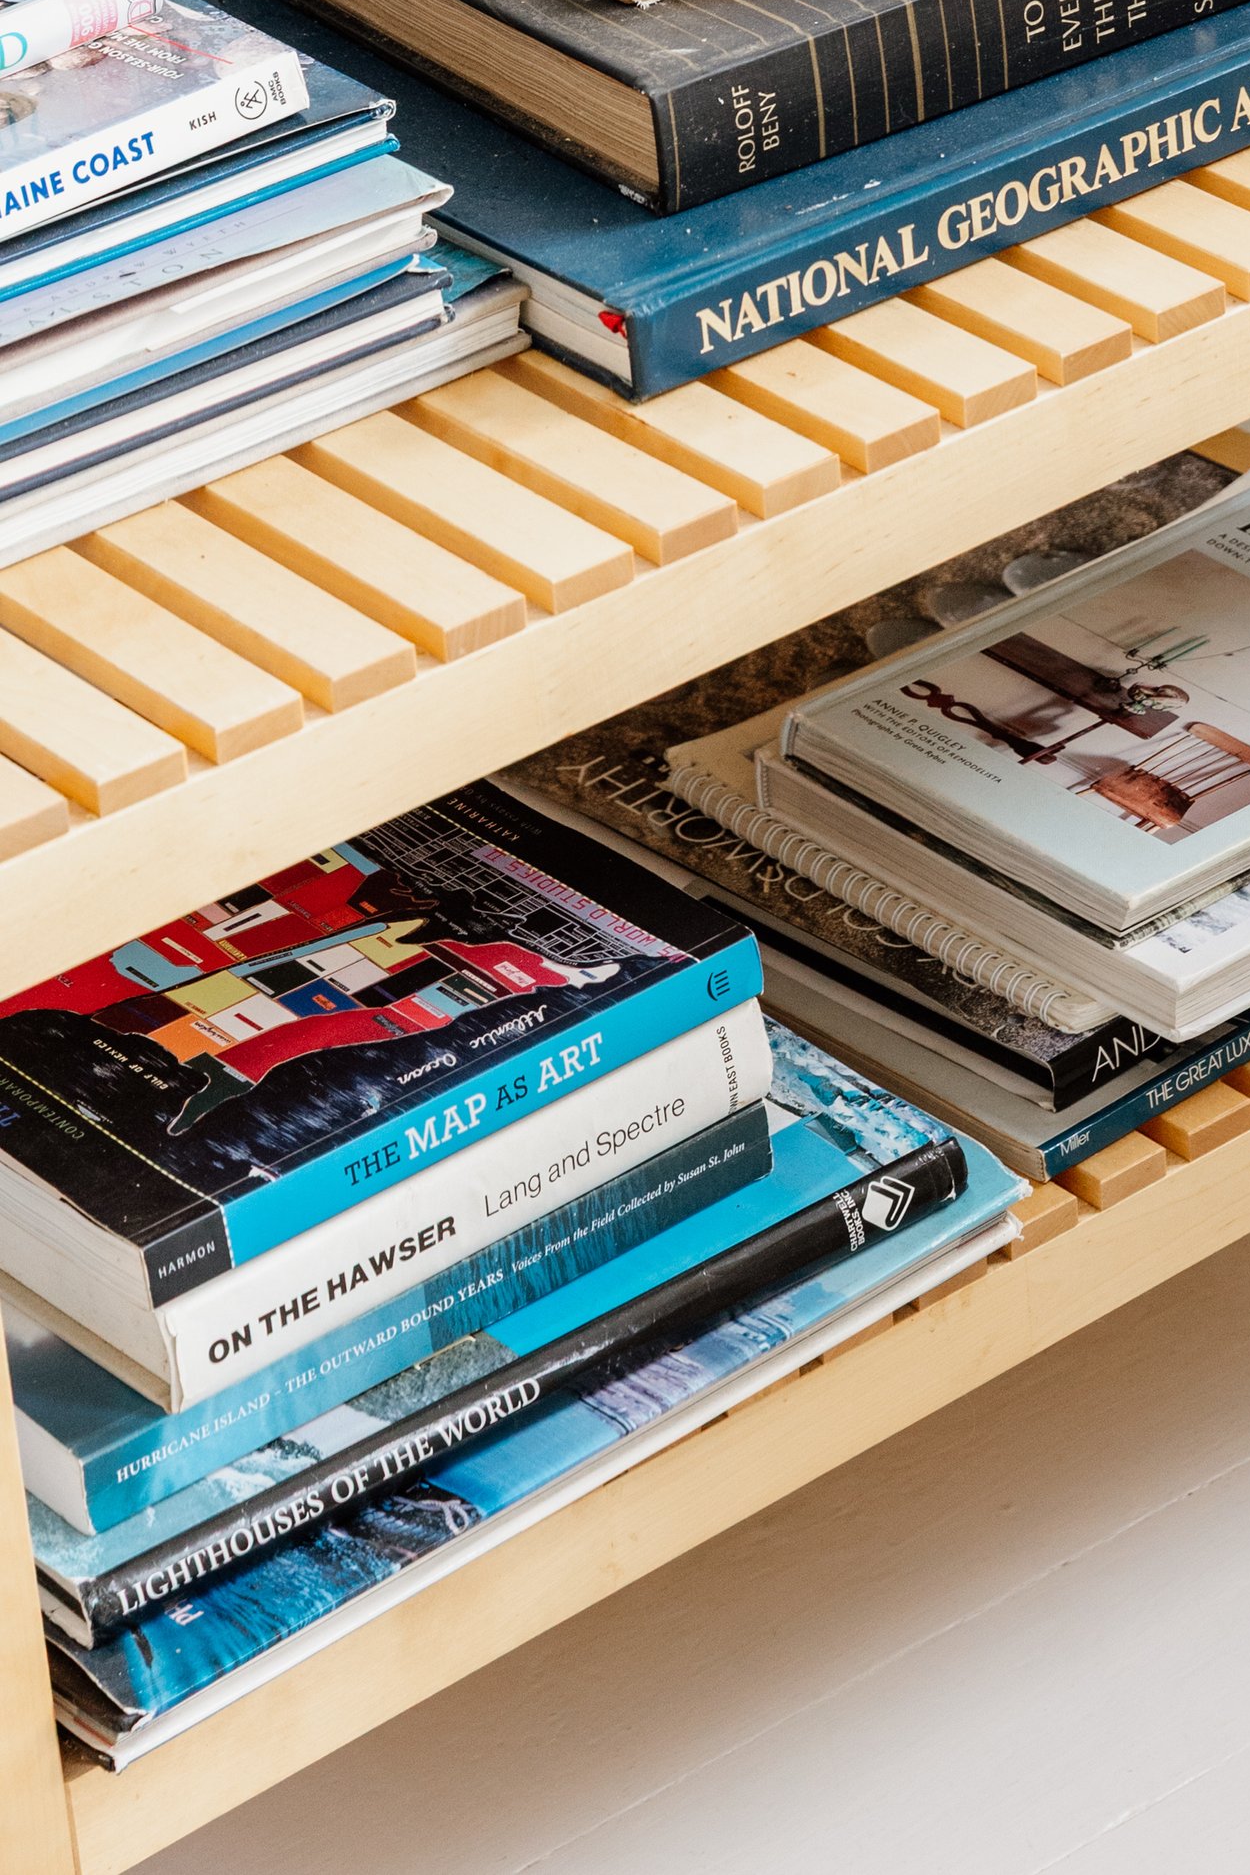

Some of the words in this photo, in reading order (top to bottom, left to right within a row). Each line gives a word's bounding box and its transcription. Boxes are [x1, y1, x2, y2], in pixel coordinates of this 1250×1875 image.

[124, 37, 149, 52] THE
[1024, 0, 1045, 43] TO
[99, 44, 184, 80] FOUR-SEASON
[149, 46, 187, 65] FROM
[268, 79, 279, 102] AMC
[273, 71, 286, 105] BOOKS
[731, 84, 755, 174] ROLOFF
[760, 91, 779, 151] BENY
[0, 170, 65, 219] AINE
[72, 131, 155, 185] COAST
[189, 111, 217, 131] KISH
[697, 223, 929, 354] NATIONAL
[936, 97, 1221, 253] GEOGRAPHIC
[1217, 532, 1228, 541] A
[851, 708, 894, 737] Photographs
[893, 733, 903, 743] by
[902, 738, 925, 754] Greta
[924, 750, 947, 765] Rybus
[863, 702, 886, 720] WITH
[885, 715, 901, 728] THE
[900, 725, 937, 747] EDITORS
[936, 745, 949, 754] OF
[947, 750, 1003, 784] REMODELISTA
[871, 698, 909, 719] ANNIE
[908, 717, 916, 727] P.
[917, 723, 967, 751] QUIGLEY
[447, 797, 520, 842] KATHARINE
[504, 860, 593, 911] STUDIES
[589, 909, 652, 948] WORLD
[92, 1038, 128, 1063] MEXICO
[469, 1004, 548, 1050] Atlantic
[716, 1025, 733, 1063] BOOKS
[397, 1053, 457, 1085] Ocean
[725, 1065, 738, 1092] EAST
[0, 1078, 85, 1140] CONTEMPORAR
[1059, 1128, 1091, 1157] Miller
[1146, 1085, 1174, 1109] THE
[1175, 1052, 1224, 1093] GREAT
[158, 1240, 217, 1279] HARMON
[344, 1142, 401, 1188] THE
[403, 1094, 487, 1161] MAP
[495, 1075, 529, 1111] AS
[536, 1031, 603, 1095] ART
[208, 1324, 253, 1364] ON
[258, 1287, 321, 1336] THE
[326, 1215, 457, 1304] HAWSER
[484, 1173, 544, 1217] Lang
[549, 1142, 591, 1181] and
[595, 1095, 688, 1158] Spectre
[832, 1191, 858, 1253] CHARTWELL
[116, 1427, 211, 1484] HURRICANE
[213, 1393, 271, 1433] ISLAND
[285, 1368, 317, 1395] THE
[319, 1326, 397, 1374] OUTWARD
[400, 1295, 454, 1334] BOUND
[456, 1268, 505, 1299] YEARS
[510, 1249, 543, 1274] Voices
[544, 1236, 571, 1260] From
[573, 1227, 589, 1247] the
[590, 1213, 615, 1237] Field
[614, 1190, 662, 1226] Collected
[662, 1179, 676, 1198] by
[677, 1163, 707, 1187] Susan
[707, 1154, 722, 1171] St.
[722, 1140, 746, 1167] John
[116, 1492, 325, 1617] LIGHTHOUSES
[330, 1469, 371, 1506] OF
[375, 1435, 434, 1482] THE
[436, 1376, 541, 1447] WORLD
